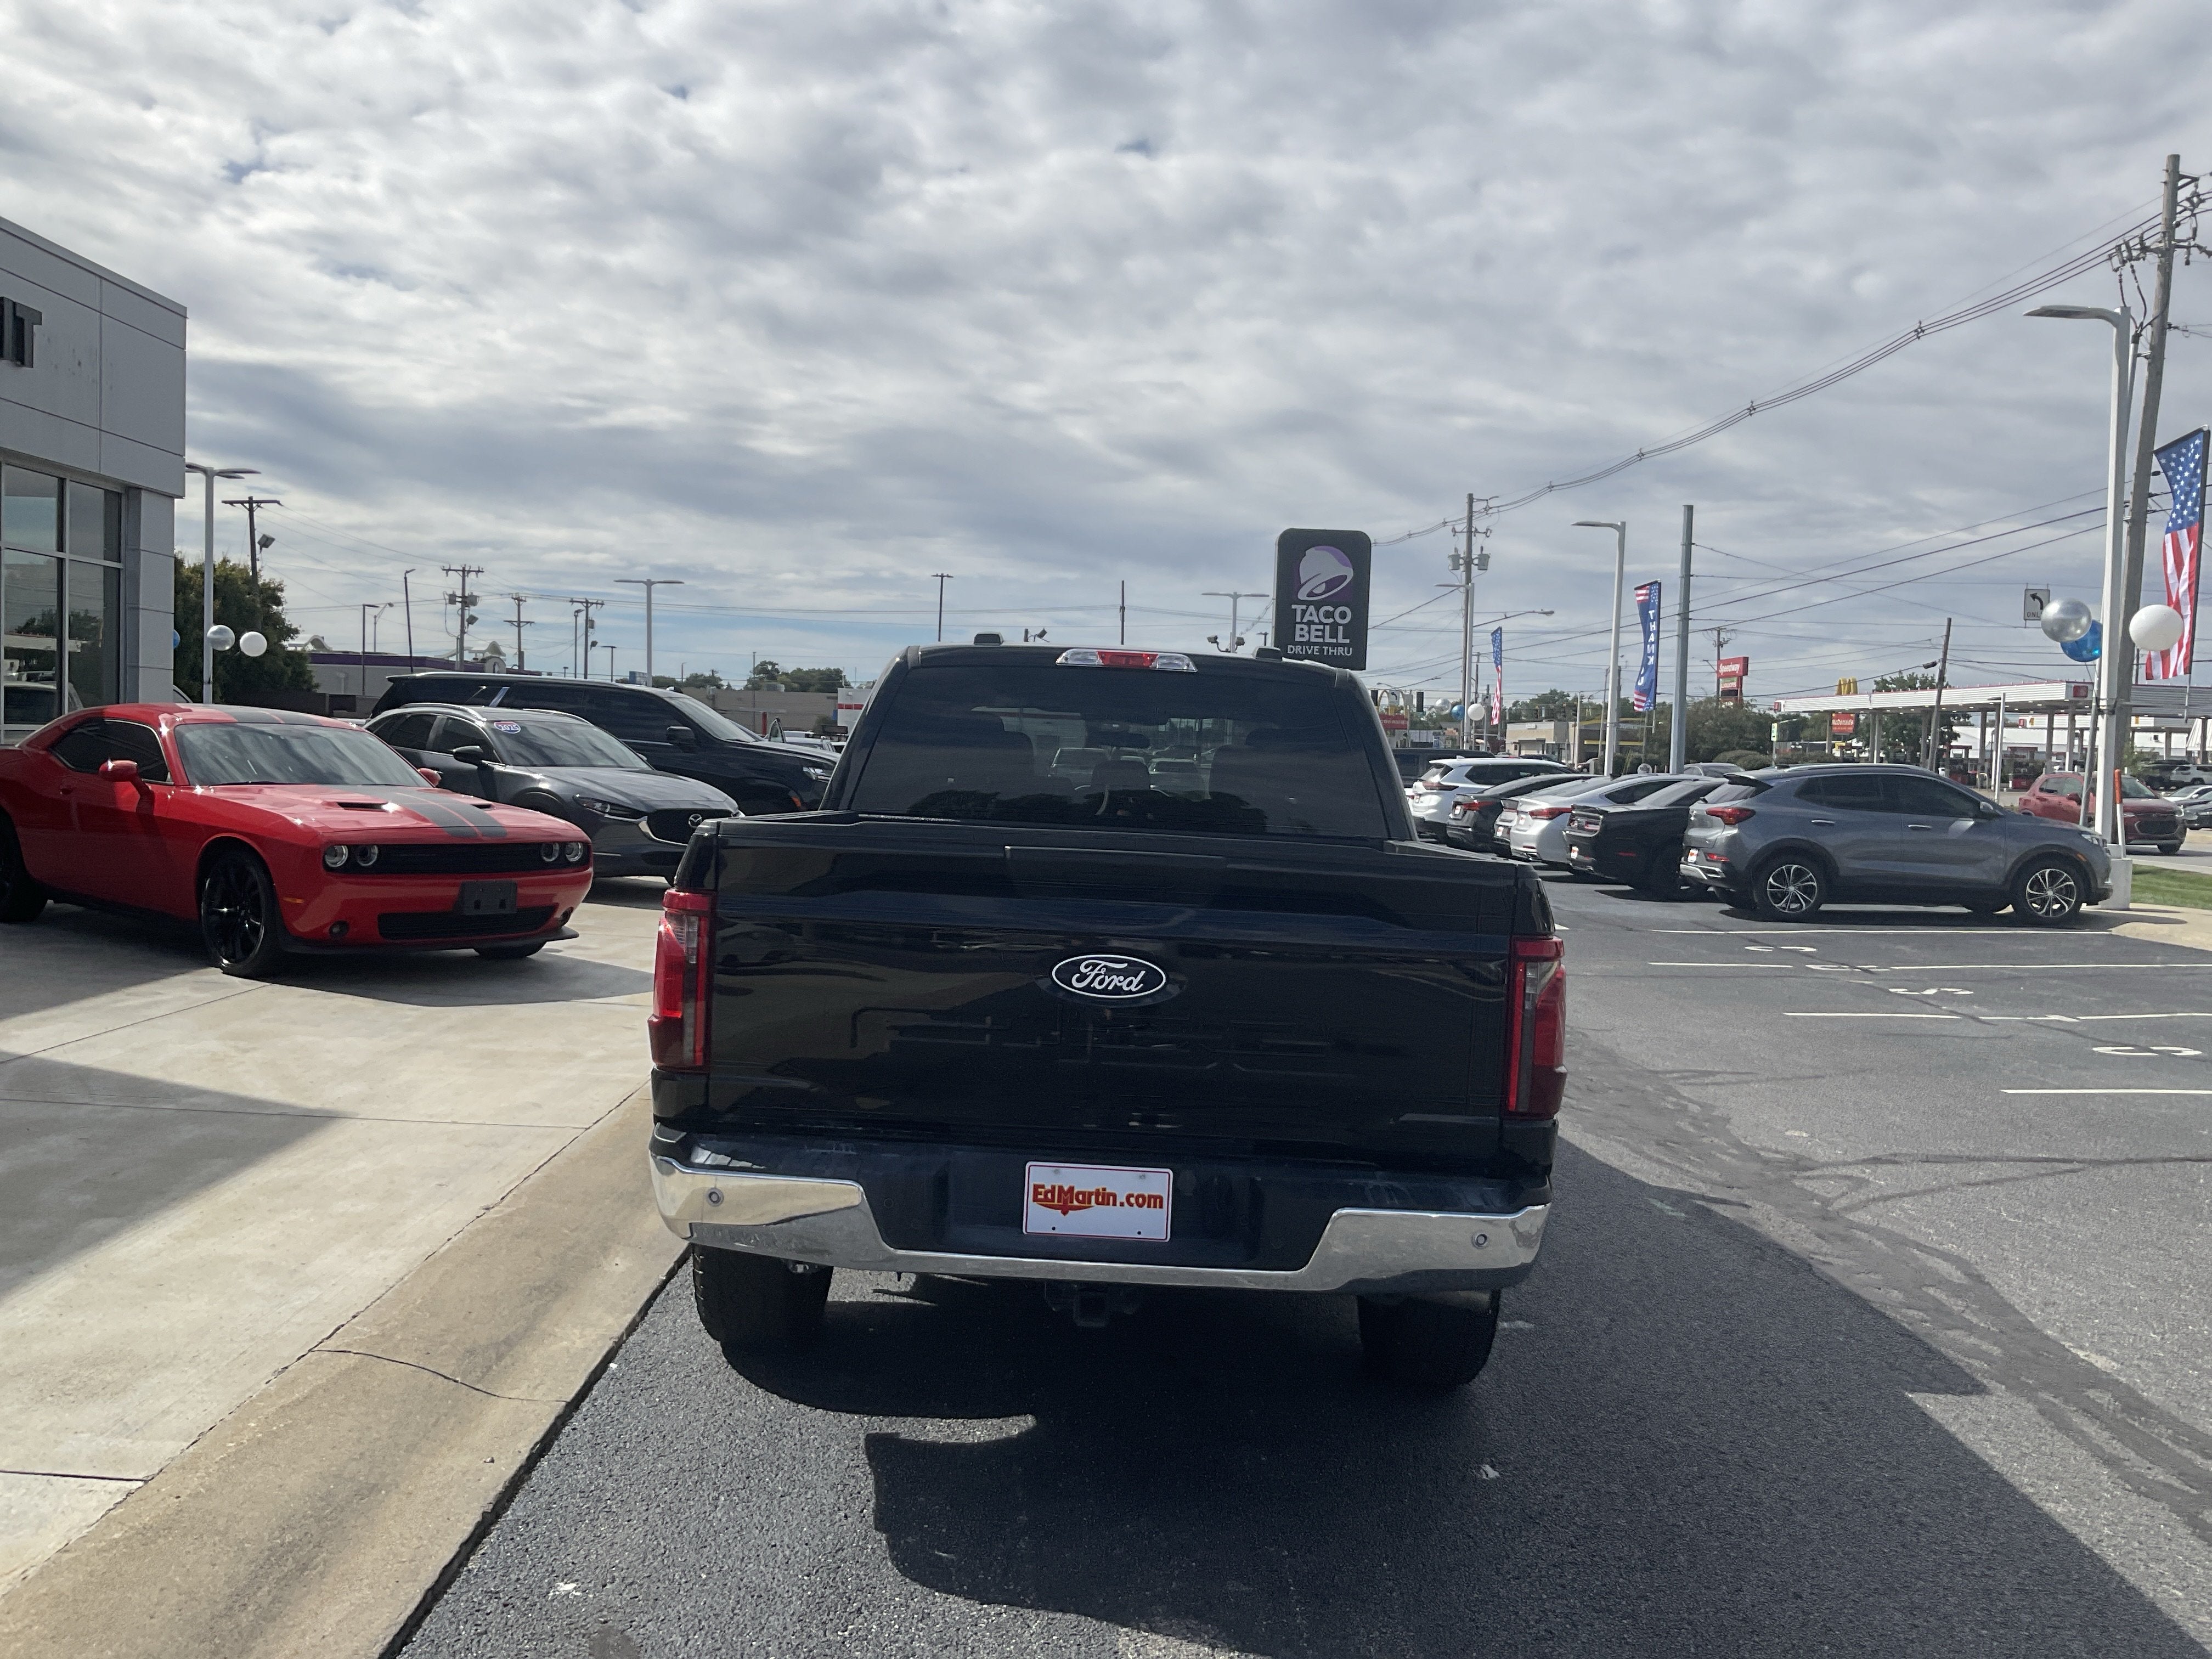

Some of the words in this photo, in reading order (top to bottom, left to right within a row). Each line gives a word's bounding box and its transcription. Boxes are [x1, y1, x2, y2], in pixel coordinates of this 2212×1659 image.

[1291, 604, 1352, 624] TACO
[1295, 624, 1350, 643] BELL
[1287, 645, 1321, 655] DRIVE
[1323, 646, 1352, 656] THRU
[1719, 662, 1740, 675] Speedway
[1071, 960, 1146, 991] Ford
[1032, 1183, 1164, 1210] EdMartin.com
